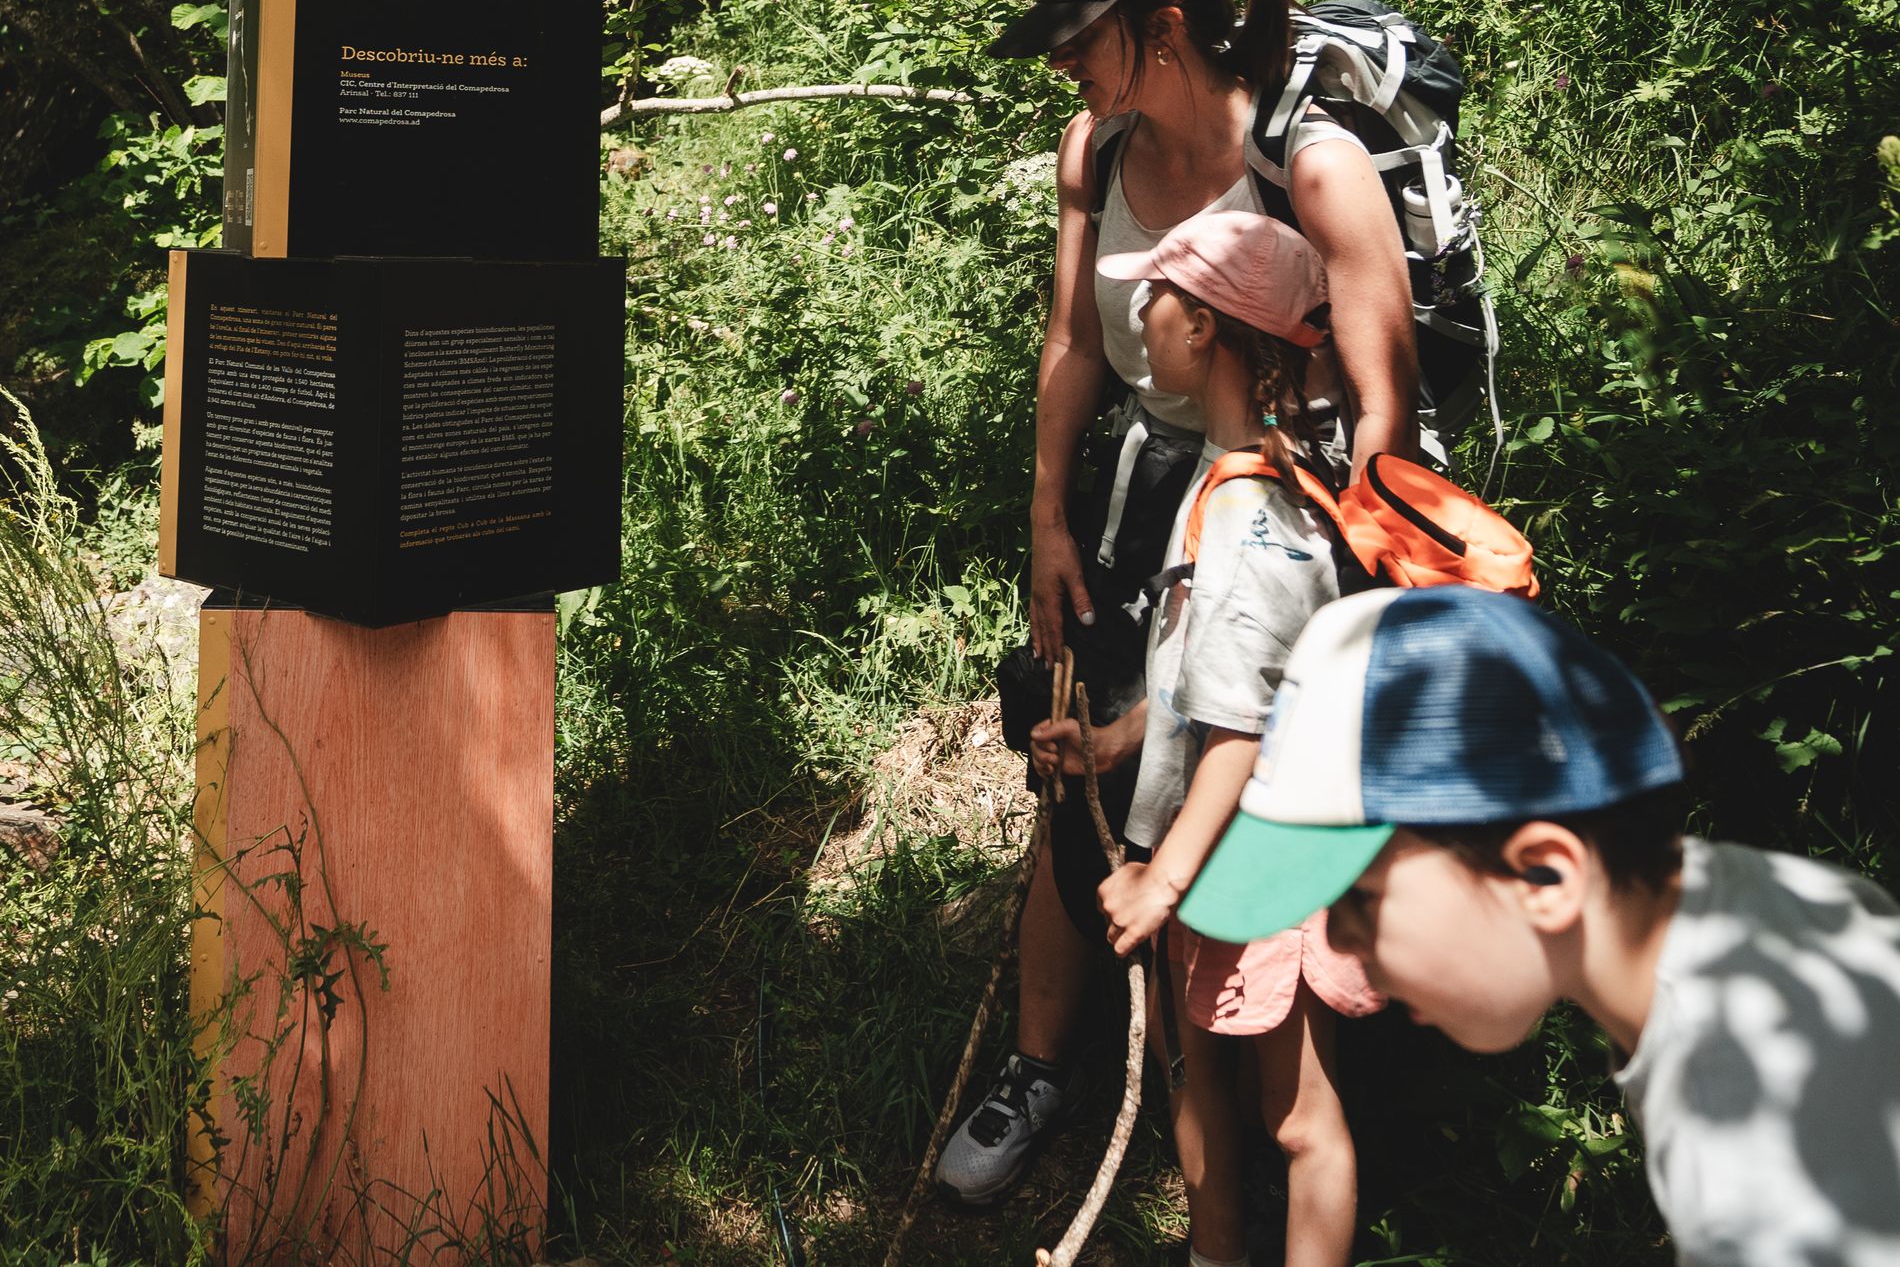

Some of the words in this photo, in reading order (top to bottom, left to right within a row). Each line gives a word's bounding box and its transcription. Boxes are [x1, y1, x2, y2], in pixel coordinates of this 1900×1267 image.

[341, 45, 464, 65] Descobriu-ne
[469, 51, 507, 67] més
[512, 56, 528, 67] a:
[340, 70, 371, 78] Museus
[340, 80, 357, 88] CIC,
[358, 80, 385, 88] Centre
[386, 81, 444, 91] d'Interpretació
[445, 83, 458, 91] del
[458, 84, 510, 93] Comapedrosa
[340, 89, 369, 97] Arinsal
[358, 107, 389, 115] Natural
[404, 109, 456, 118] Comapedrosa
[339, 117, 420, 126] www.comapedrosa.ad
